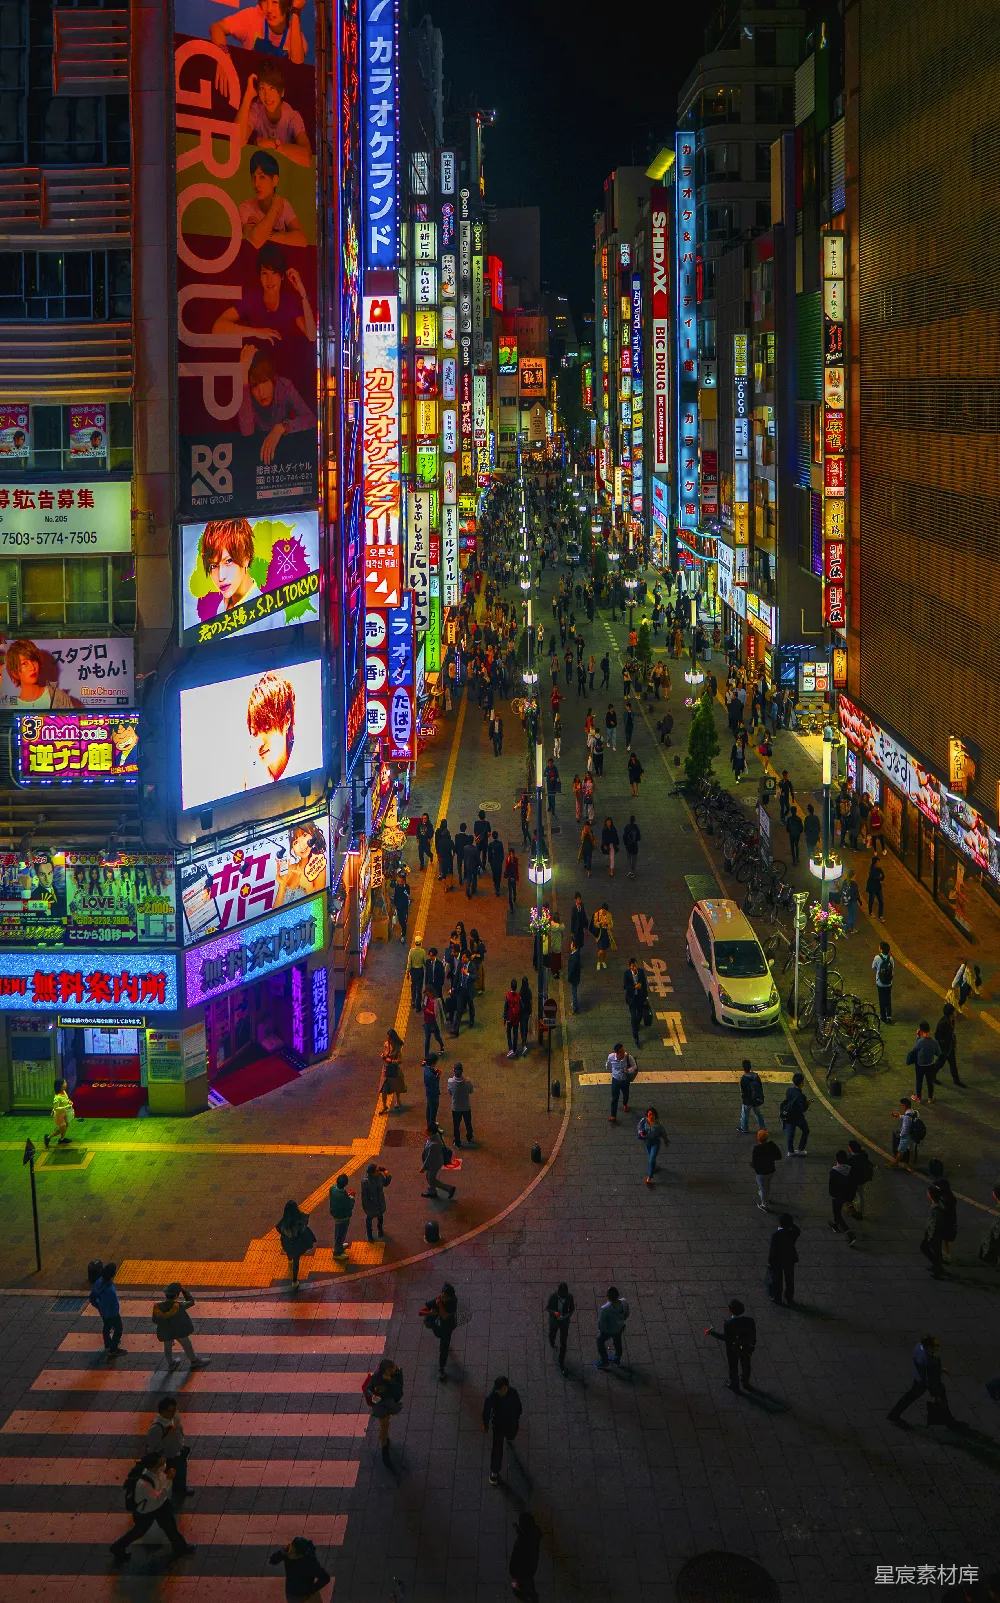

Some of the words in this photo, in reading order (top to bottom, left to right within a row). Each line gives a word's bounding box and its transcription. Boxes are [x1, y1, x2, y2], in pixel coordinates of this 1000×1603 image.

[368, 36, 394, 253] カラオケランド
[175, 39, 243, 421] GROUP
[652, 211, 667, 295] SHIDAX
[655, 326, 666, 350] BIC
[655, 352, 666, 391] DRUG
[684, 413, 695, 515] カラオケ館
[44, 515, 68, 523] No.205
[192, 497, 208, 506] RAIN
[209, 496, 234, 504] GROUP
[1, 531, 98, 546] 7503-5774-7505
[283, 574, 319, 603] TOKYO
[51, 644, 108, 665] スタプロ
[77, 660, 128, 681] かもん!
[394, 693, 409, 744] たばこ
[29, 742, 113, 772] 逆ナン館
[210, 850, 272, 899] ポケ
[219, 880, 276, 931] パラ
[69, 928, 122, 942] ここから30秒
[200, 915, 318, 993] 無料案内所
[32, 969, 167, 1004] 無料案内所
[312, 966, 329, 1056] 無料案内所
